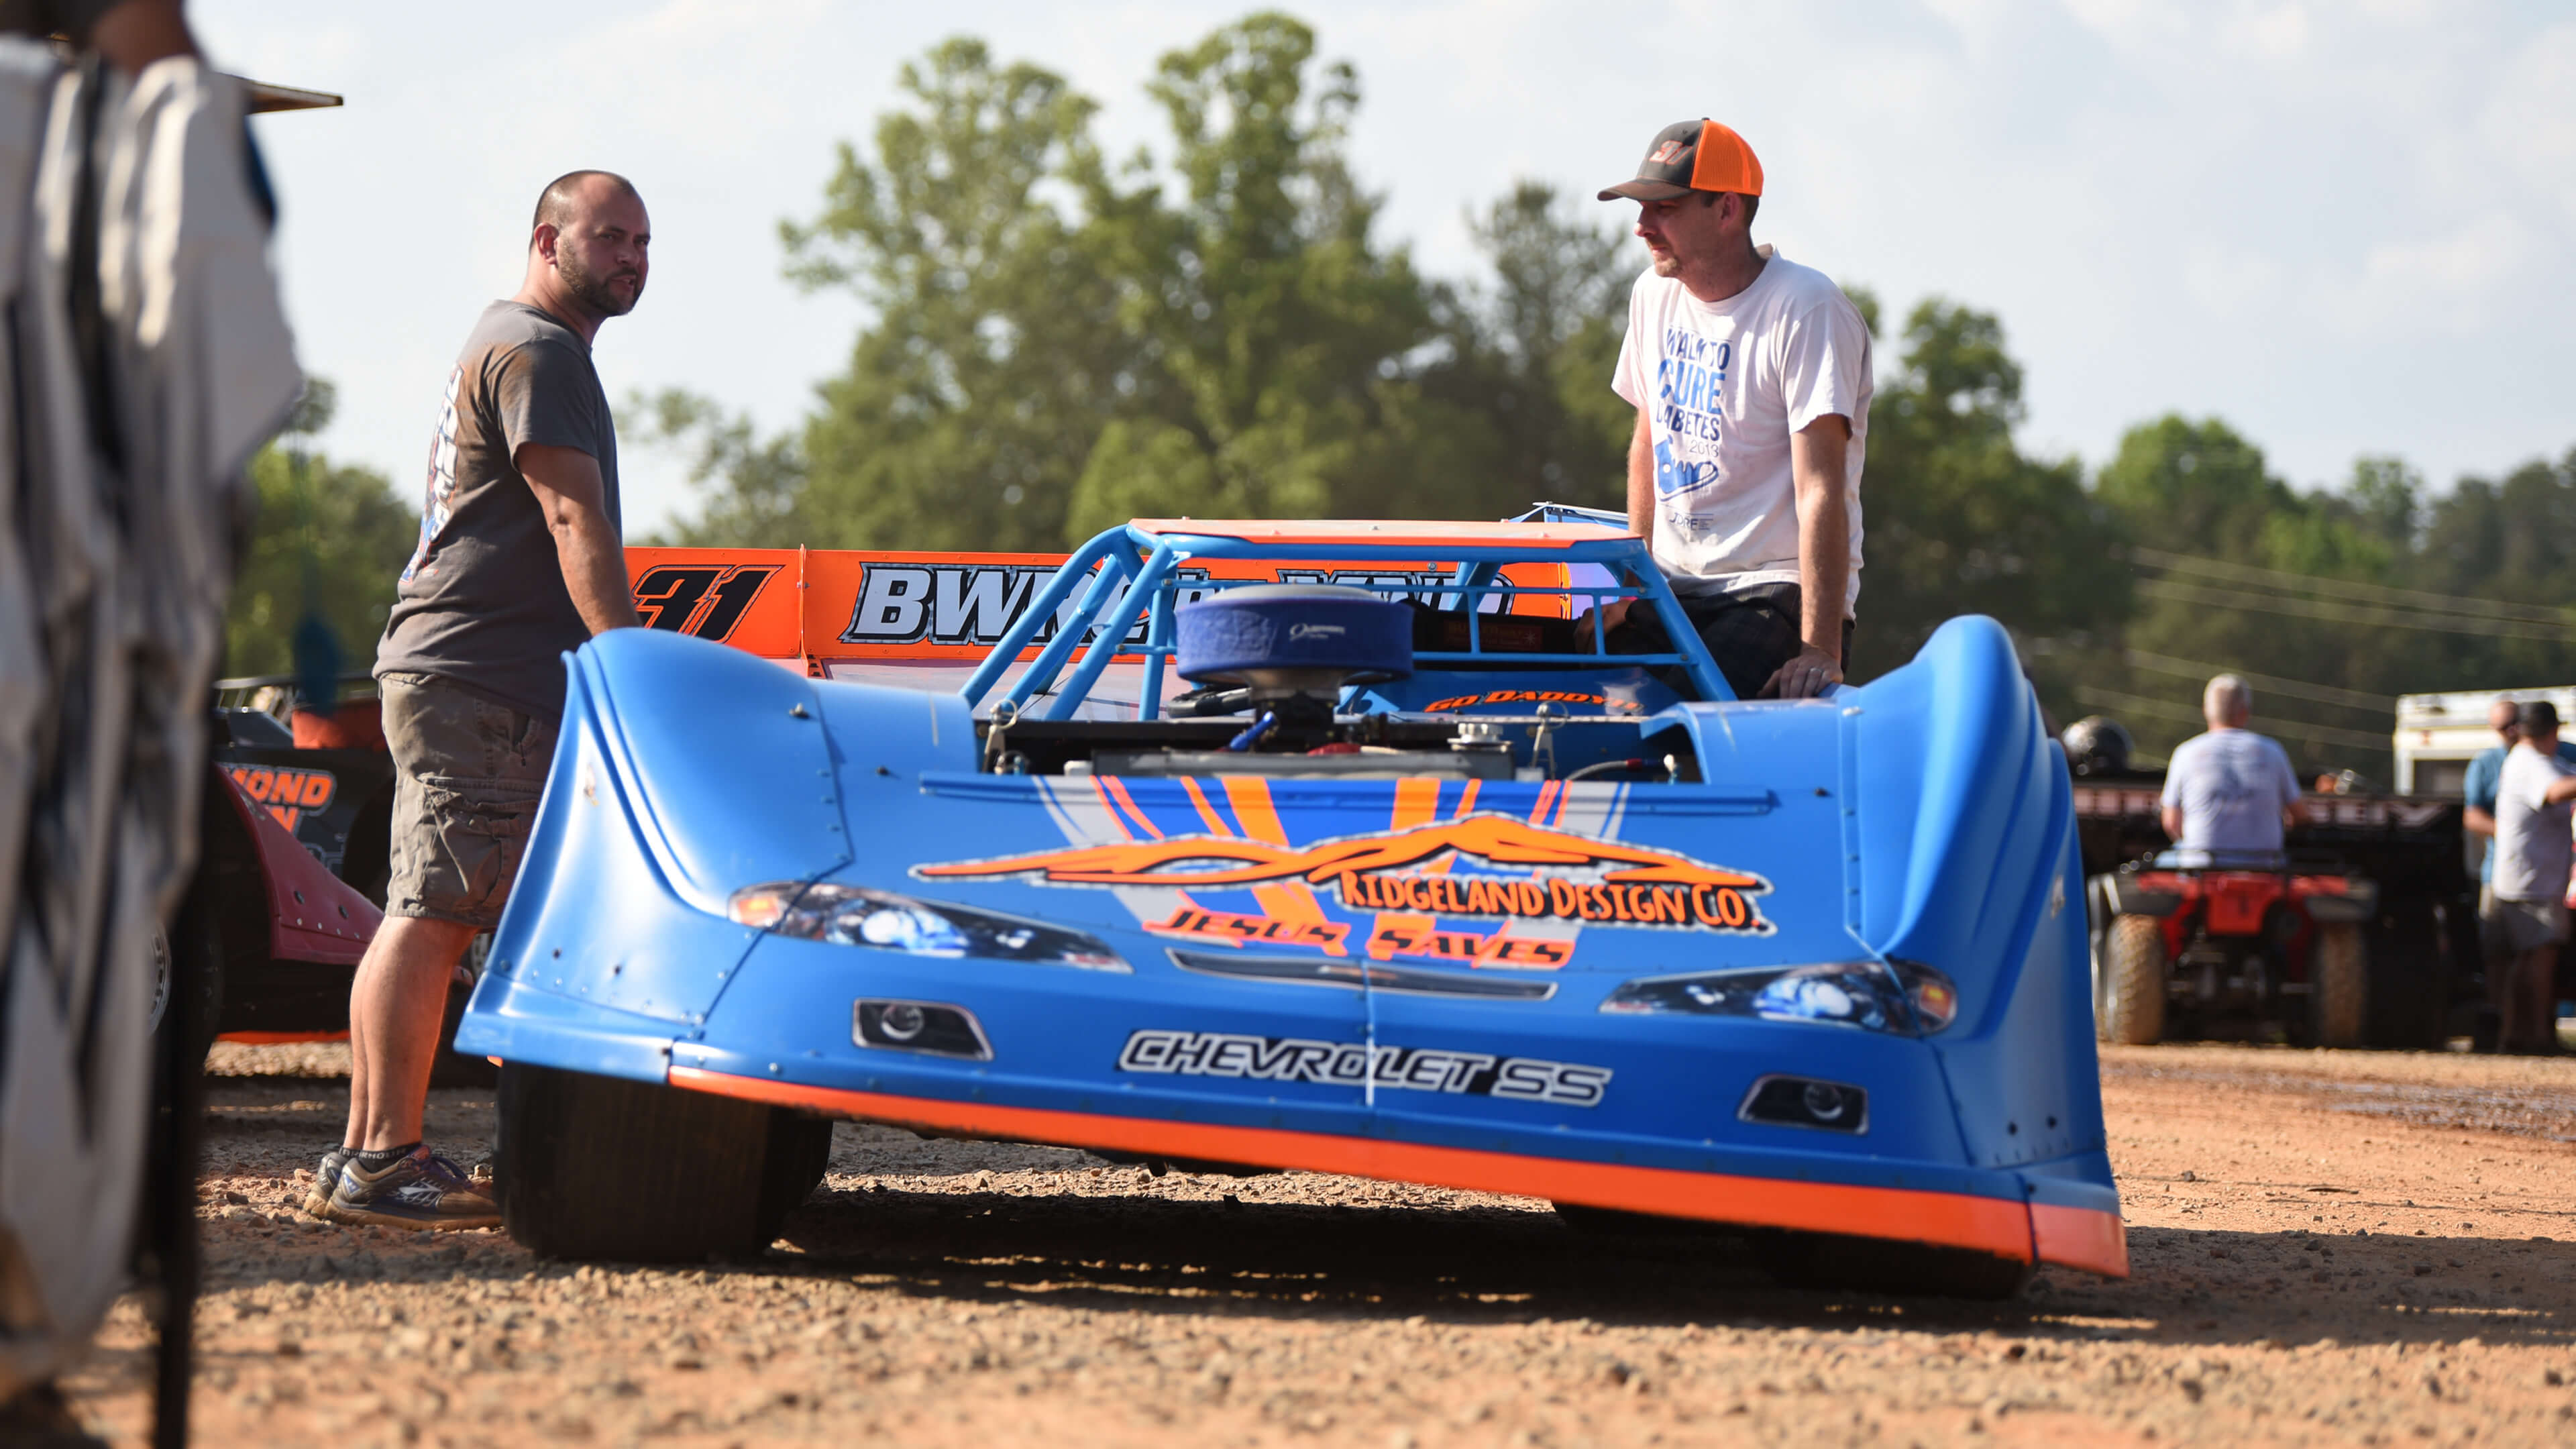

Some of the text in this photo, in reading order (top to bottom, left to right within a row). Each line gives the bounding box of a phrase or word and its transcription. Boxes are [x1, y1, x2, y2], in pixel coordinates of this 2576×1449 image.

[1649, 139, 1693, 165] 31
[1709, 341, 1731, 371] TO
[1658, 357, 1726, 415] CURE
[1688, 439, 1720, 458] 2013
[631, 564, 785, 643] 31
[1424, 695, 1479, 712] GO
[1341, 871, 1762, 928] RIDGELAND DESIGN CO.
[1152, 904, 1572, 966] JESUS SAVES
[1118, 1030, 1613, 1107] CHEVROLET SS
